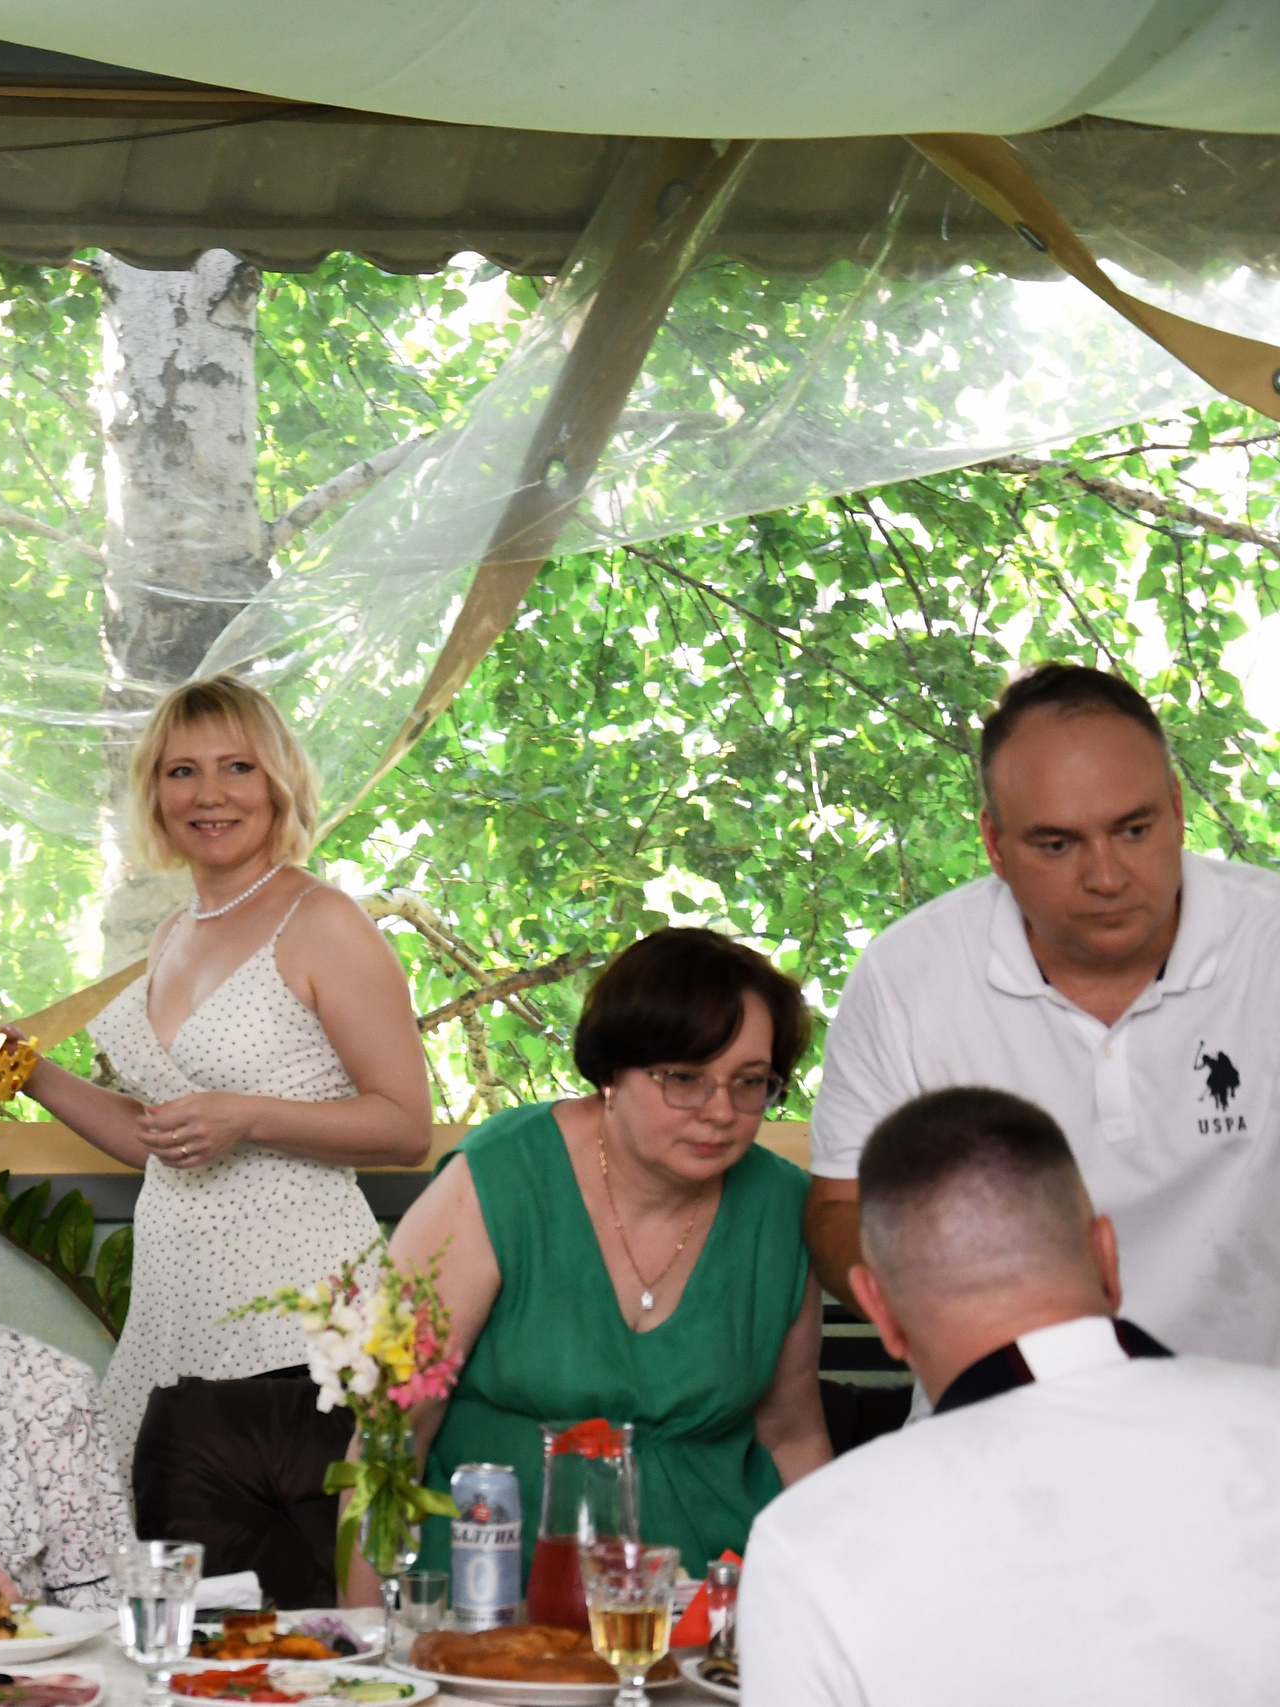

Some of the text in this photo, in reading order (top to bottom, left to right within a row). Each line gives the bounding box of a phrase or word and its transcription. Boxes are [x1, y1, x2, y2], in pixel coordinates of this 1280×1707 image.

[1198, 1115, 1247, 1134] USPA
[451, 1528, 520, 1545] БАЛТИК
[466, 1556, 498, 1600] 0
